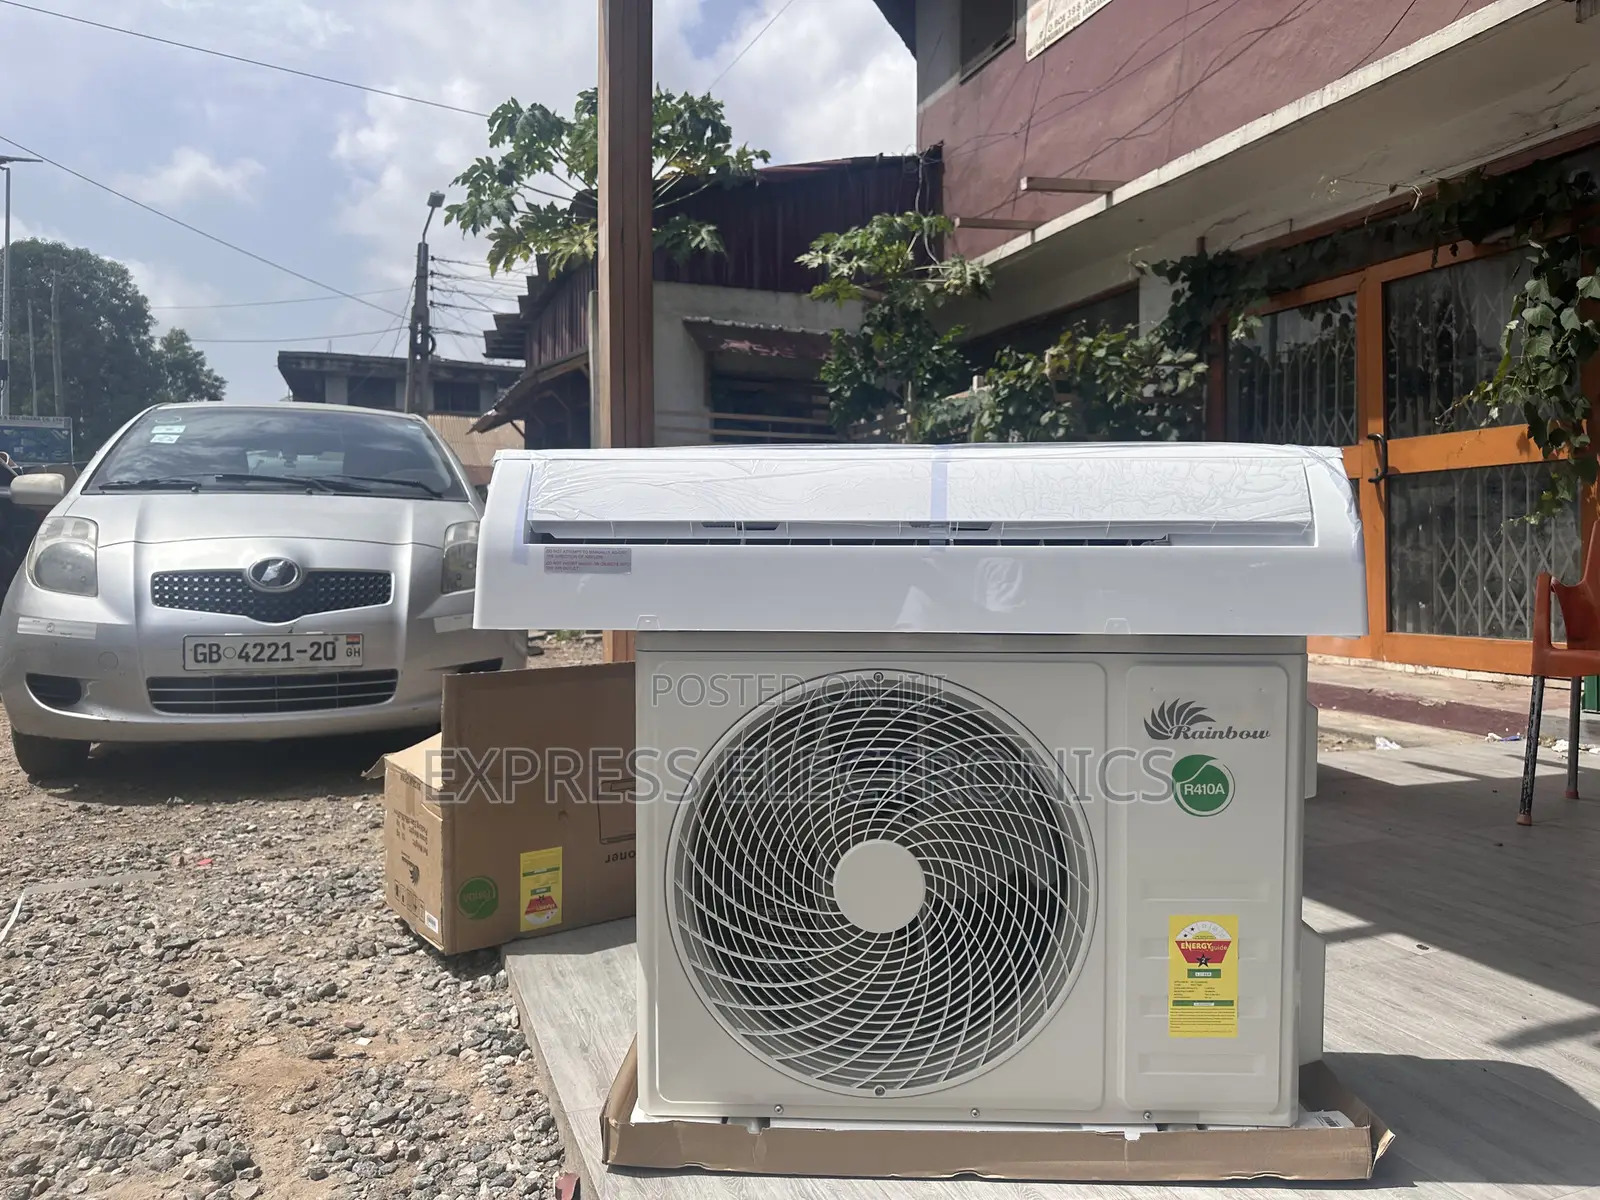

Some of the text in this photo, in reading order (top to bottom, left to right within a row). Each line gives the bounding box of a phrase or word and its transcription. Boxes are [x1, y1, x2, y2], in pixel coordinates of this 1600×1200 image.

[193, 641, 337, 664] GB 4221-20
[345, 647, 361, 658] GH
[1168, 724, 1271, 740] Rainbow
[1183, 783, 1226, 795] R410A
